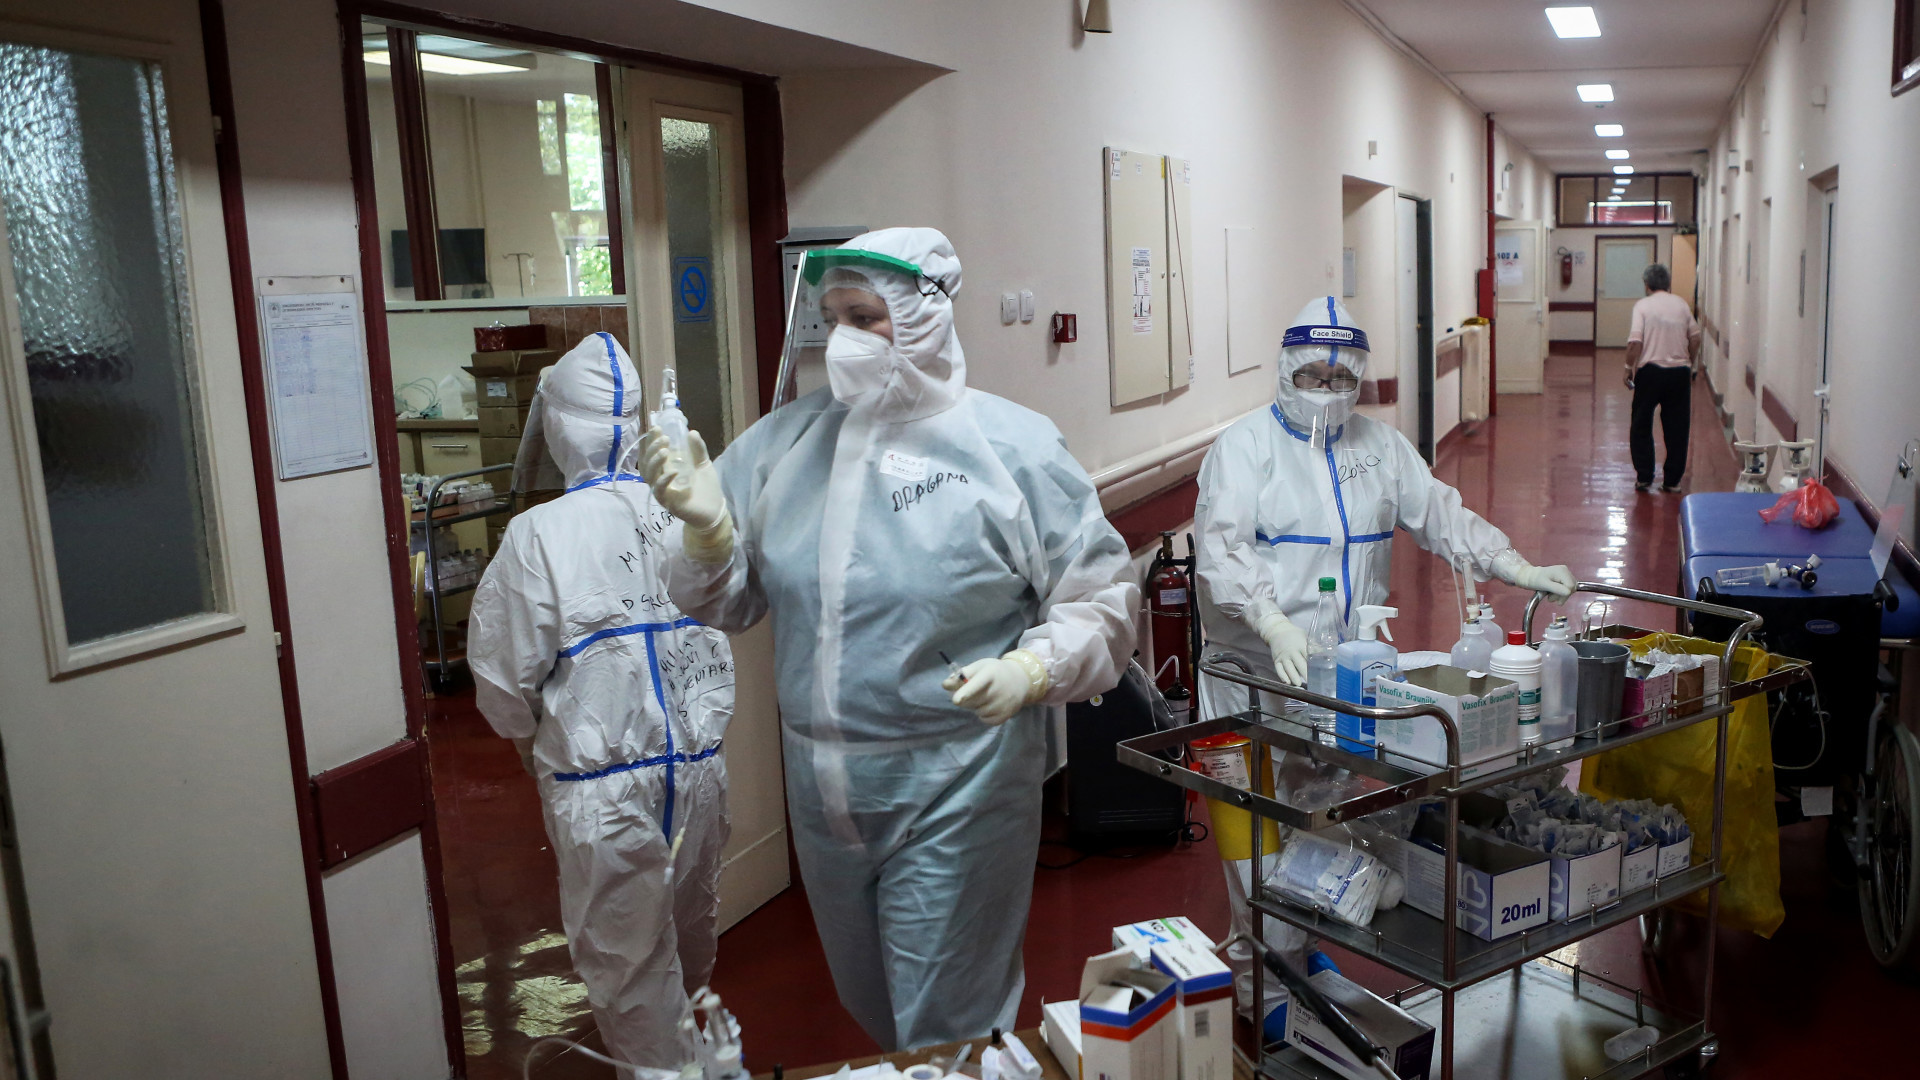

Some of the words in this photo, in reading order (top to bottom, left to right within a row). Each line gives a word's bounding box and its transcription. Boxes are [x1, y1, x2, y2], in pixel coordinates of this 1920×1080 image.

[1331, 330, 1352, 339] Shield
[1378, 683, 1403, 698] Vasofix
[1405, 691, 1437, 705] Braunüle
[1462, 699, 1487, 711] Vasofix
[1489, 691, 1516, 705] Braunüle
[1501, 897, 1541, 925] 20ml
